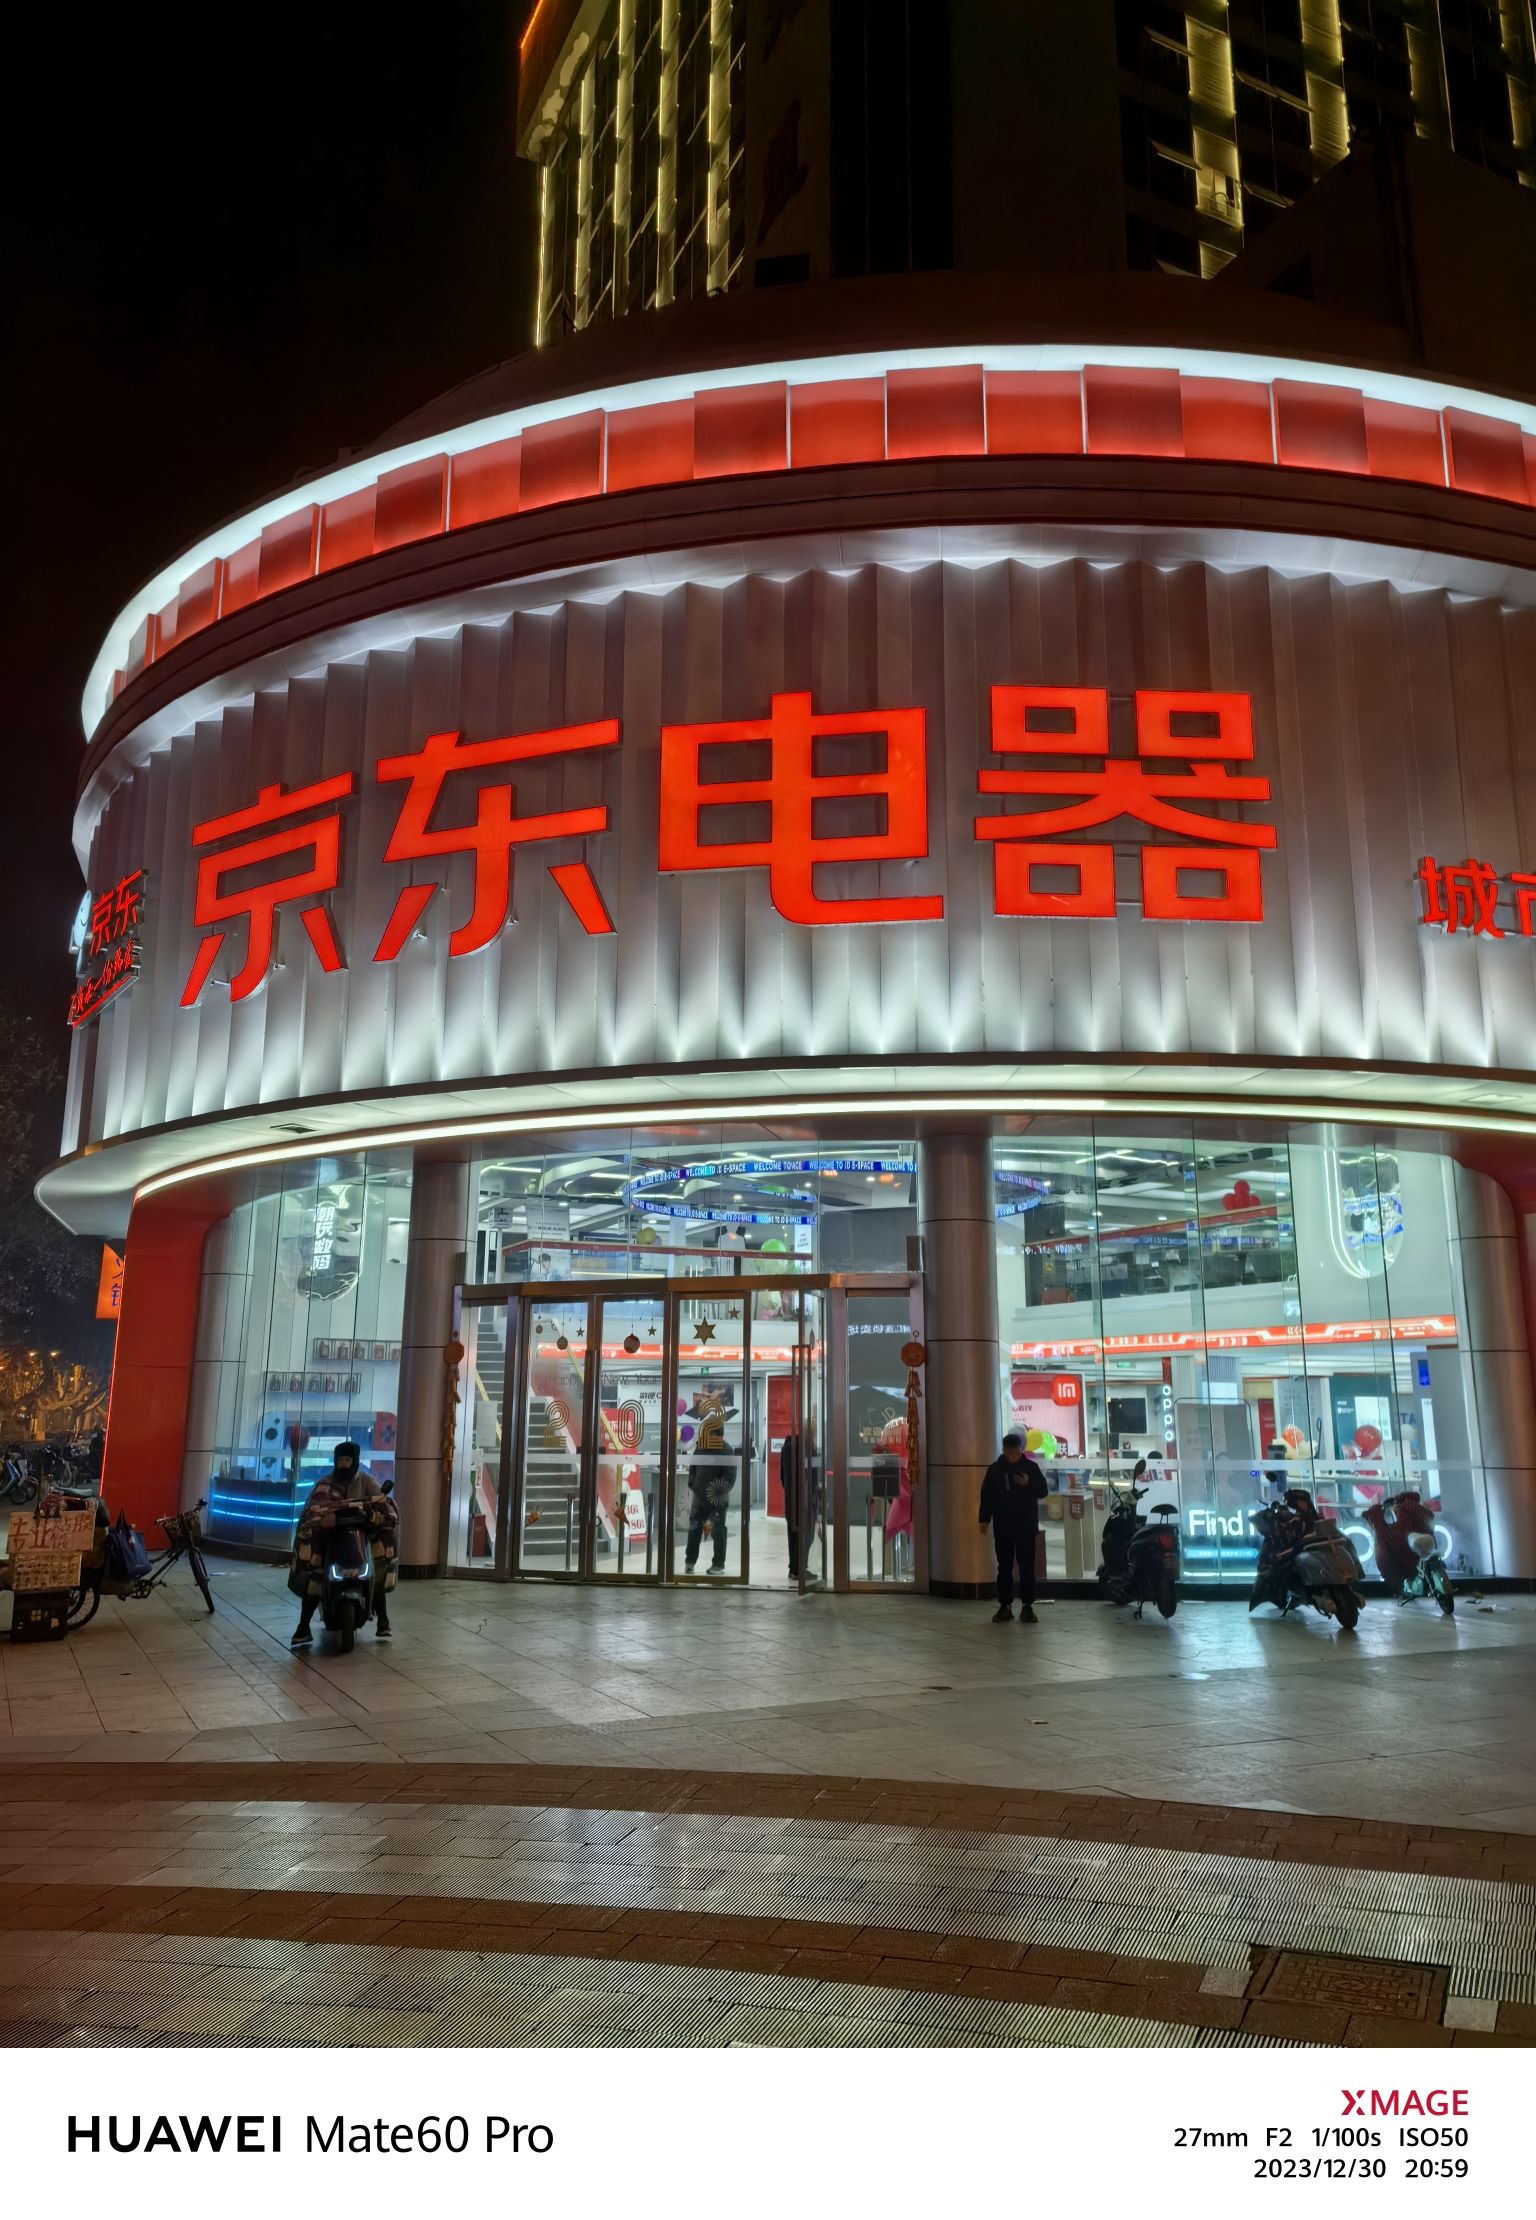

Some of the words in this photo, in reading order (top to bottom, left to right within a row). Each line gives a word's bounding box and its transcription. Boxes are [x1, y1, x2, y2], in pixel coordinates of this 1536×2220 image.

[182, 685, 1277, 1006] 京东电器
[89, 868, 142, 957] 京东
[724, 1162, 746, 1174] E-SPACE
[809, 1160, 835, 1171] WELCOME
[852, 1160, 875, 1170] E-SPACE
[880, 1161, 906, 1171] WELCOME
[313, 1206, 336, 1270] 潮玩数码
[603, 1373, 627, 1386] New
[1188, 1509, 1244, 1537] Find
